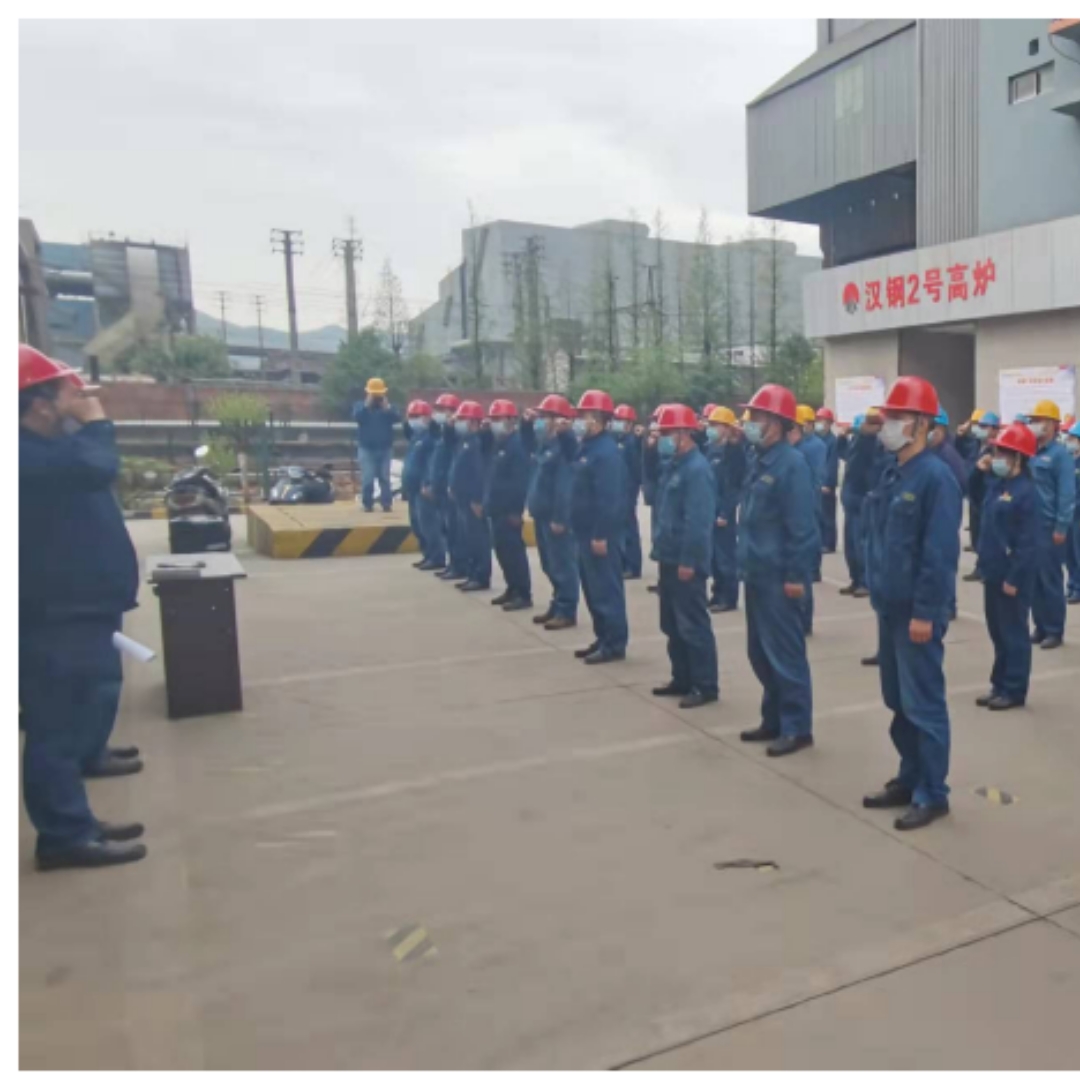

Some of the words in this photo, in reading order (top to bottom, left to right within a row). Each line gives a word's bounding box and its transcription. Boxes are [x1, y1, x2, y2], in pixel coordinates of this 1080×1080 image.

[865, 257, 996, 312] 汉钢2号高炉
